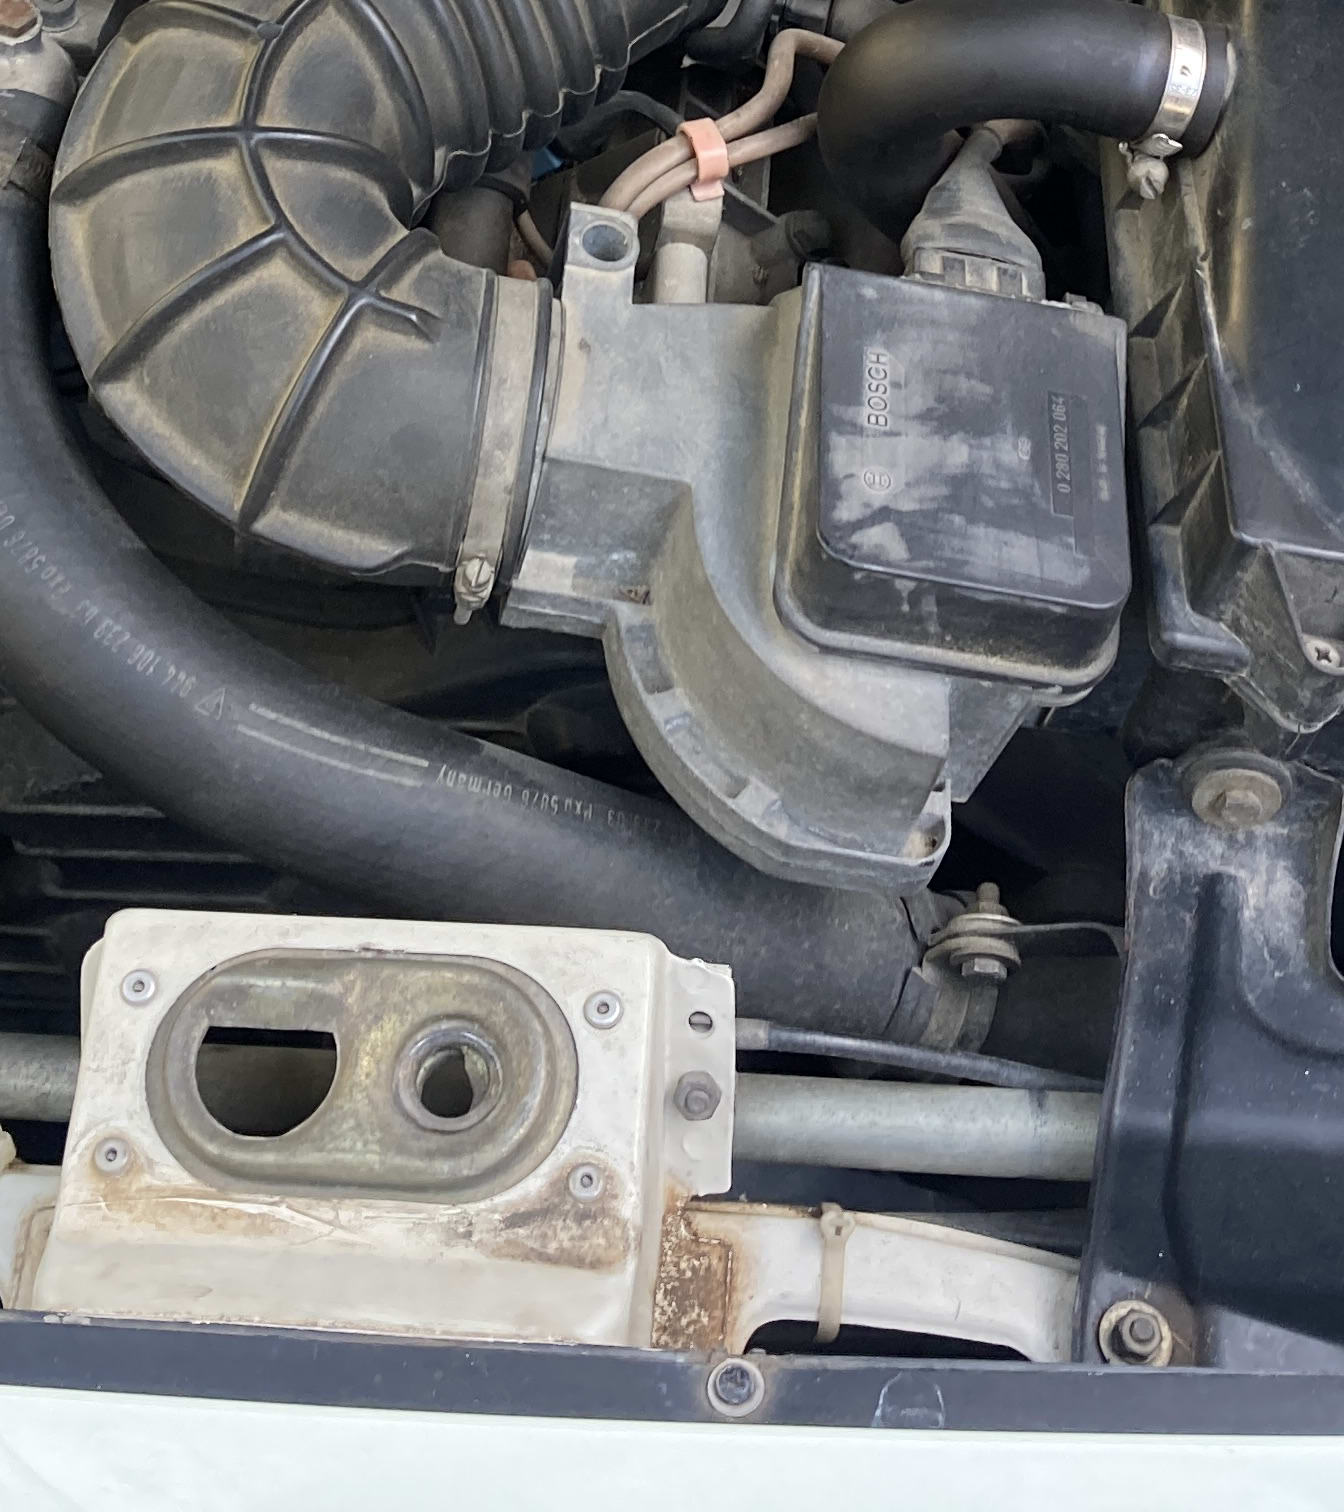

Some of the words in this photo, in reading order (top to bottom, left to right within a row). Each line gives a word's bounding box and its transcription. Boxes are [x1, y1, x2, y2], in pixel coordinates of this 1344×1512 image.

[867, 351, 888, 428] BOSCH
[1052, 396, 1068, 422] 064
[1054, 424, 1069, 451] 202
[1055, 454, 1071, 482] 280
[1057, 484, 1071, 494] 0
